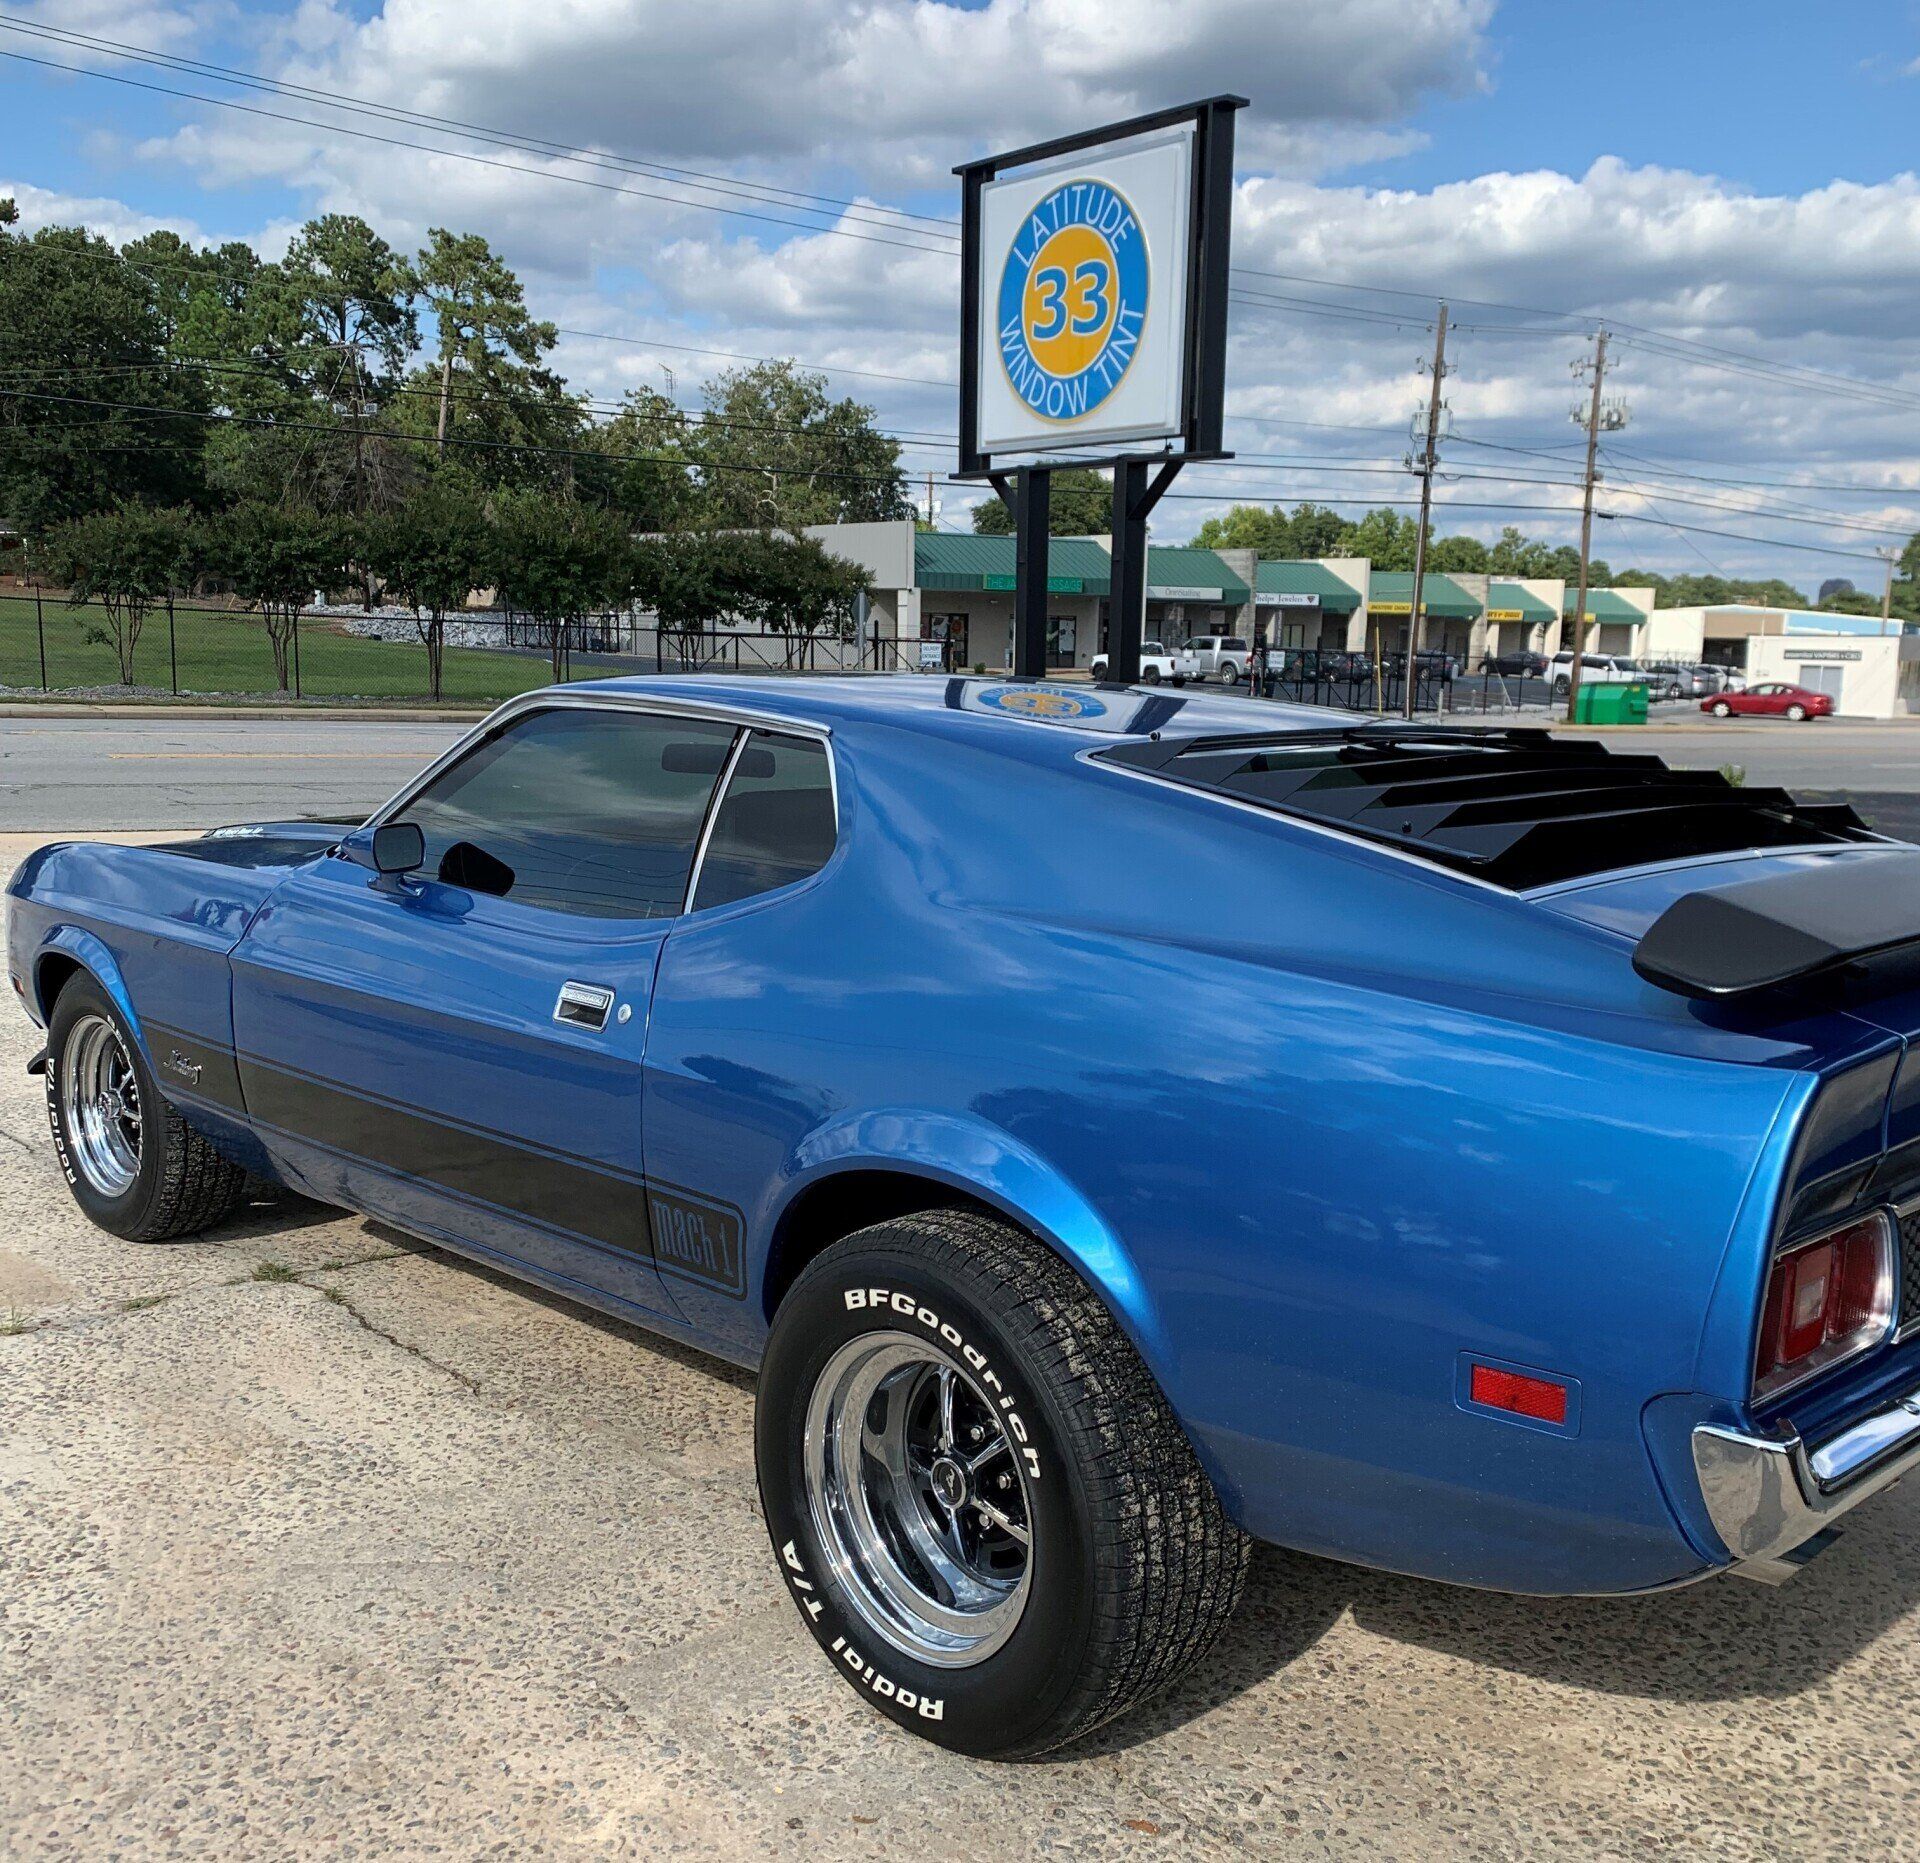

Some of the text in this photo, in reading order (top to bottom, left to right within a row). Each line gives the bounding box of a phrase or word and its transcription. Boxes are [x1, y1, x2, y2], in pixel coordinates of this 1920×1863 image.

[1013, 186, 1136, 267] LATITUDE
[999, 299, 1144, 417] WINDOW TINT
[1032, 259, 1110, 340] 33
[844, 1288, 1042, 1480] BFGoodrich
[782, 1538, 945, 1721] Radial T/A
